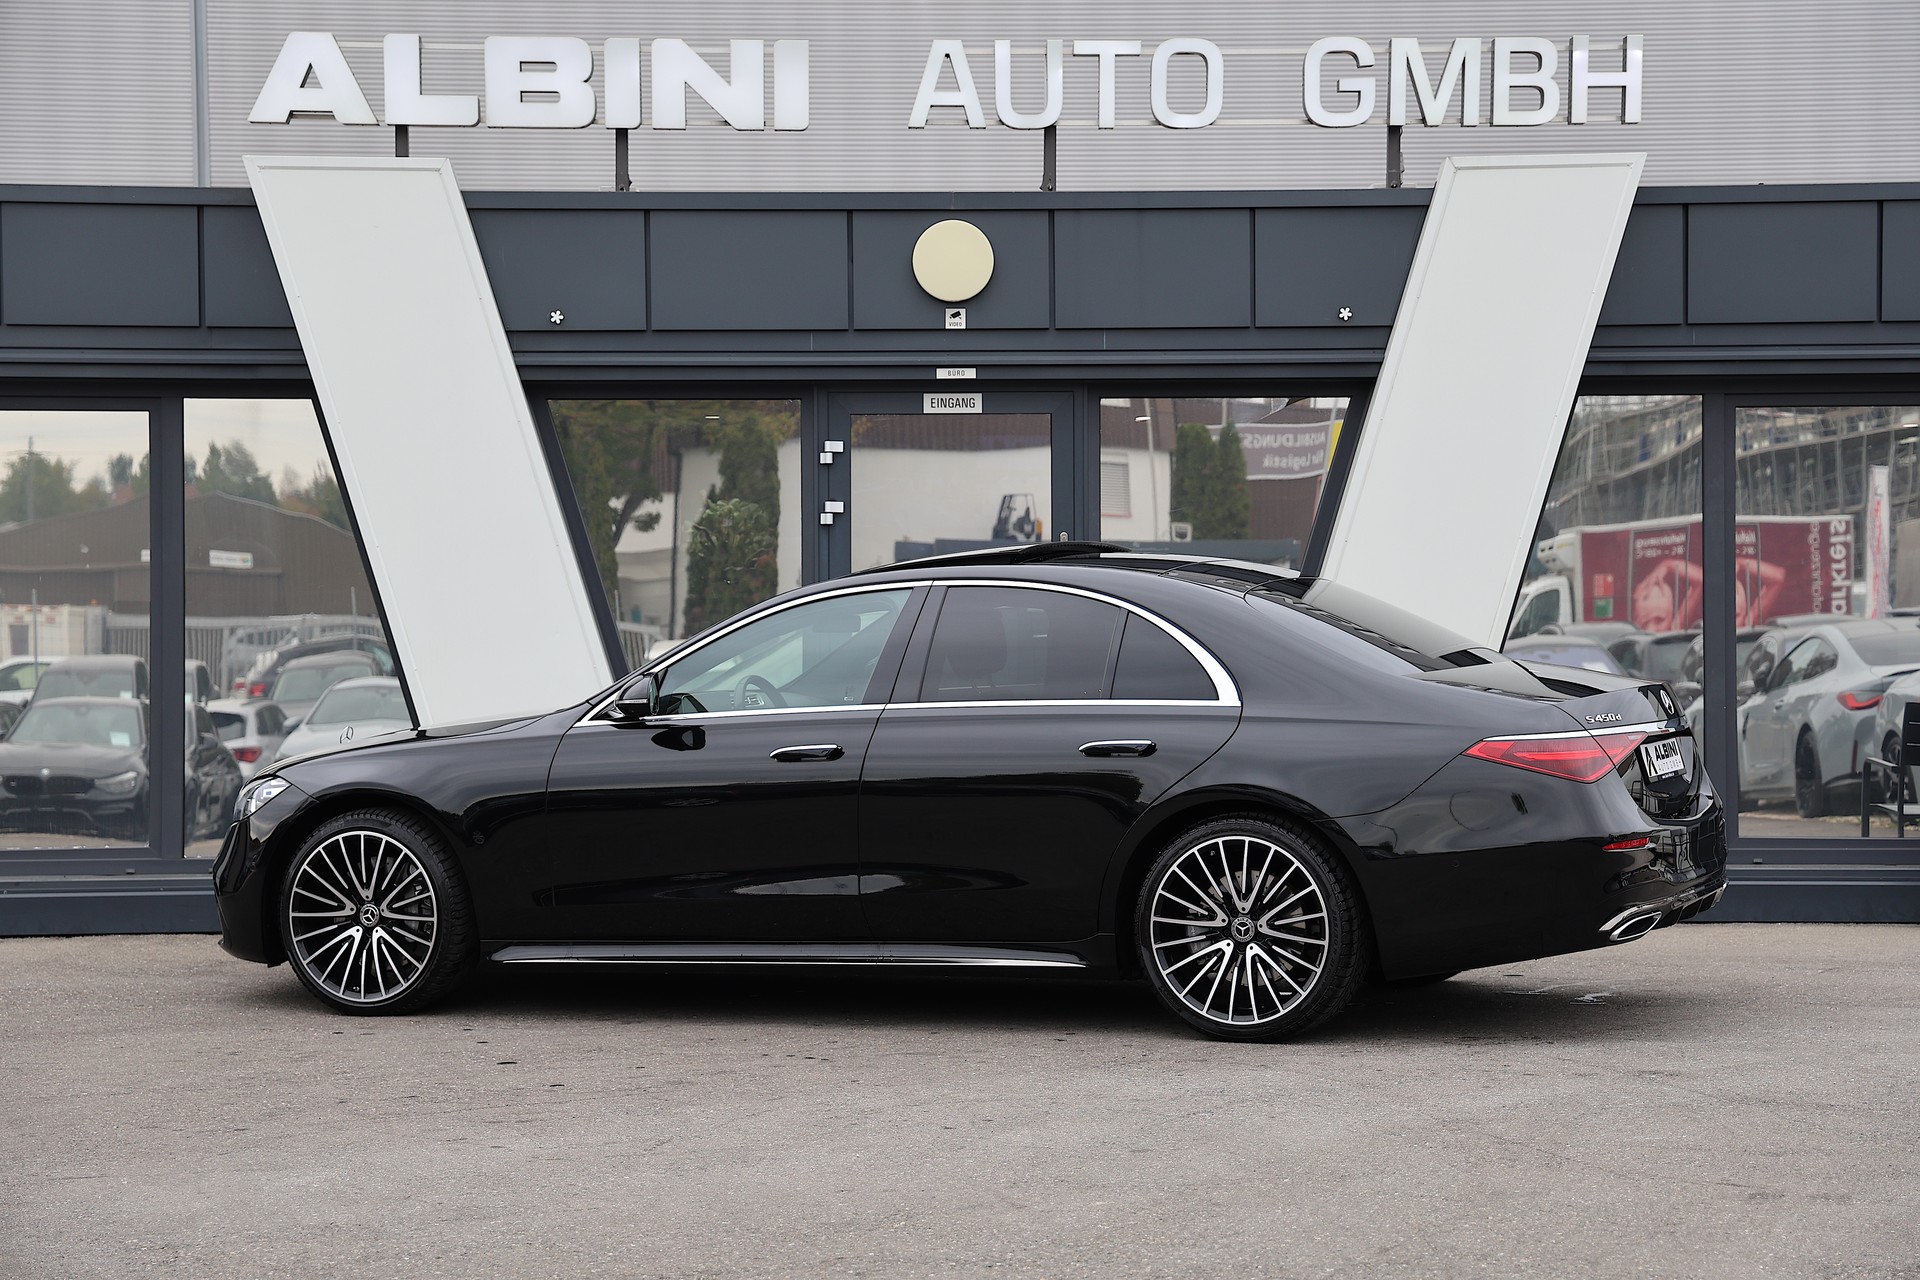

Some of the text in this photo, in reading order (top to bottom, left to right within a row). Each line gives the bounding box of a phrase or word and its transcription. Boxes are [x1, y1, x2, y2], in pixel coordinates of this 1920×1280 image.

[247, 31, 1644, 131] ALBINI AUTO GMBH
[947, 369, 966, 377] BÜRO
[930, 397, 976, 409] EINGANG
[1654, 740, 1679, 761] ALBINI
